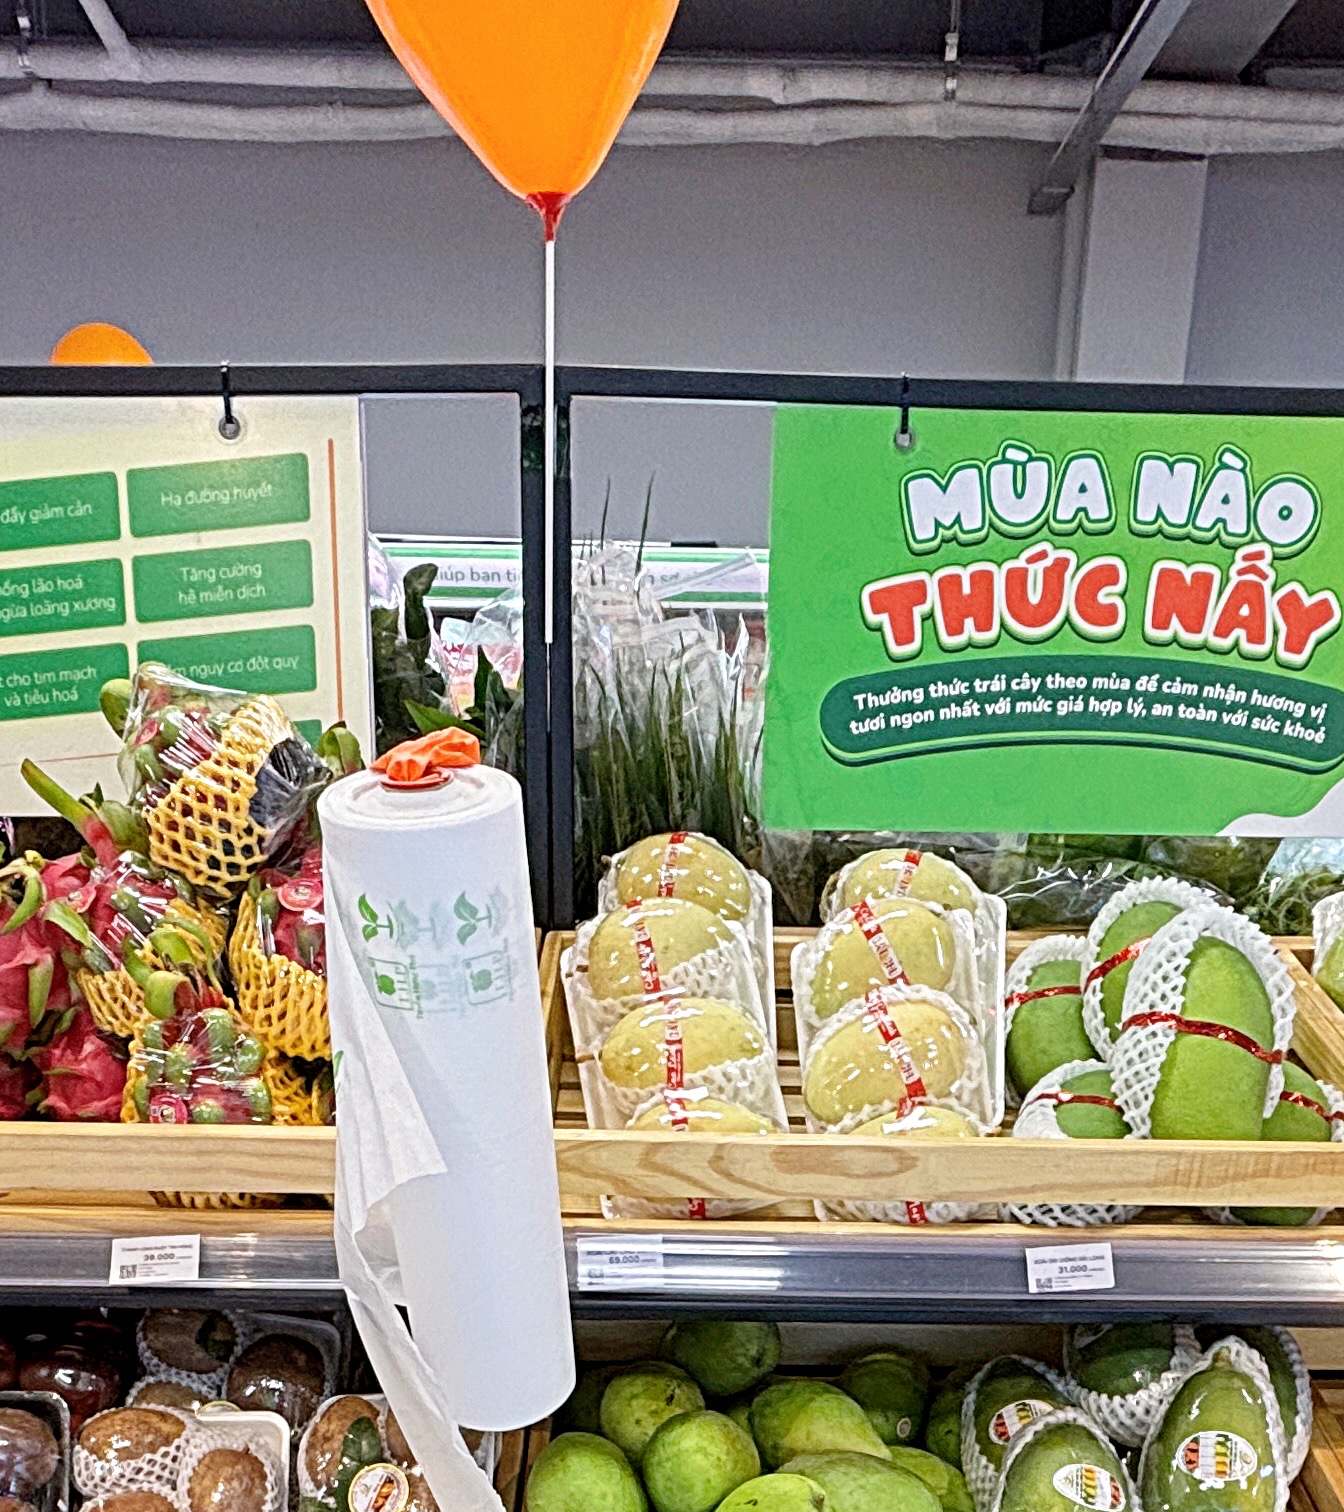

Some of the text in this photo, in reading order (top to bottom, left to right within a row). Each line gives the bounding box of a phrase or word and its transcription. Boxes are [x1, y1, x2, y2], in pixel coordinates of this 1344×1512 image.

[903, 440, 1321, 556] MÙA NÀO
[1, 505, 26, 526] đẩy
[29, 503, 64, 524] giảm
[32, 576, 54, 594] lão
[57, 574, 83, 591] hoá
[180, 561, 262, 584] Tăng cường
[438, 565, 465, 584] iúp
[470, 566, 500, 583] bạn
[72, 596, 116, 612] xương
[199, 585, 234, 603] miễn
[862, 544, 1127, 660] THỨC
[6, 671, 31, 687] cho
[34, 669, 56, 684] tim
[58, 664, 96, 683] mạch
[190, 661, 225, 680] nguy
[4, 686, 78, 708] và tiêu hoá
[853, 672, 1328, 724] Thưởng thức trái cây theo mùa để cảm nhận hương vị
[849, 695, 1327, 744] tươi ngon nhất với mức giá hợp lý, an toàn với sức khoẻ
